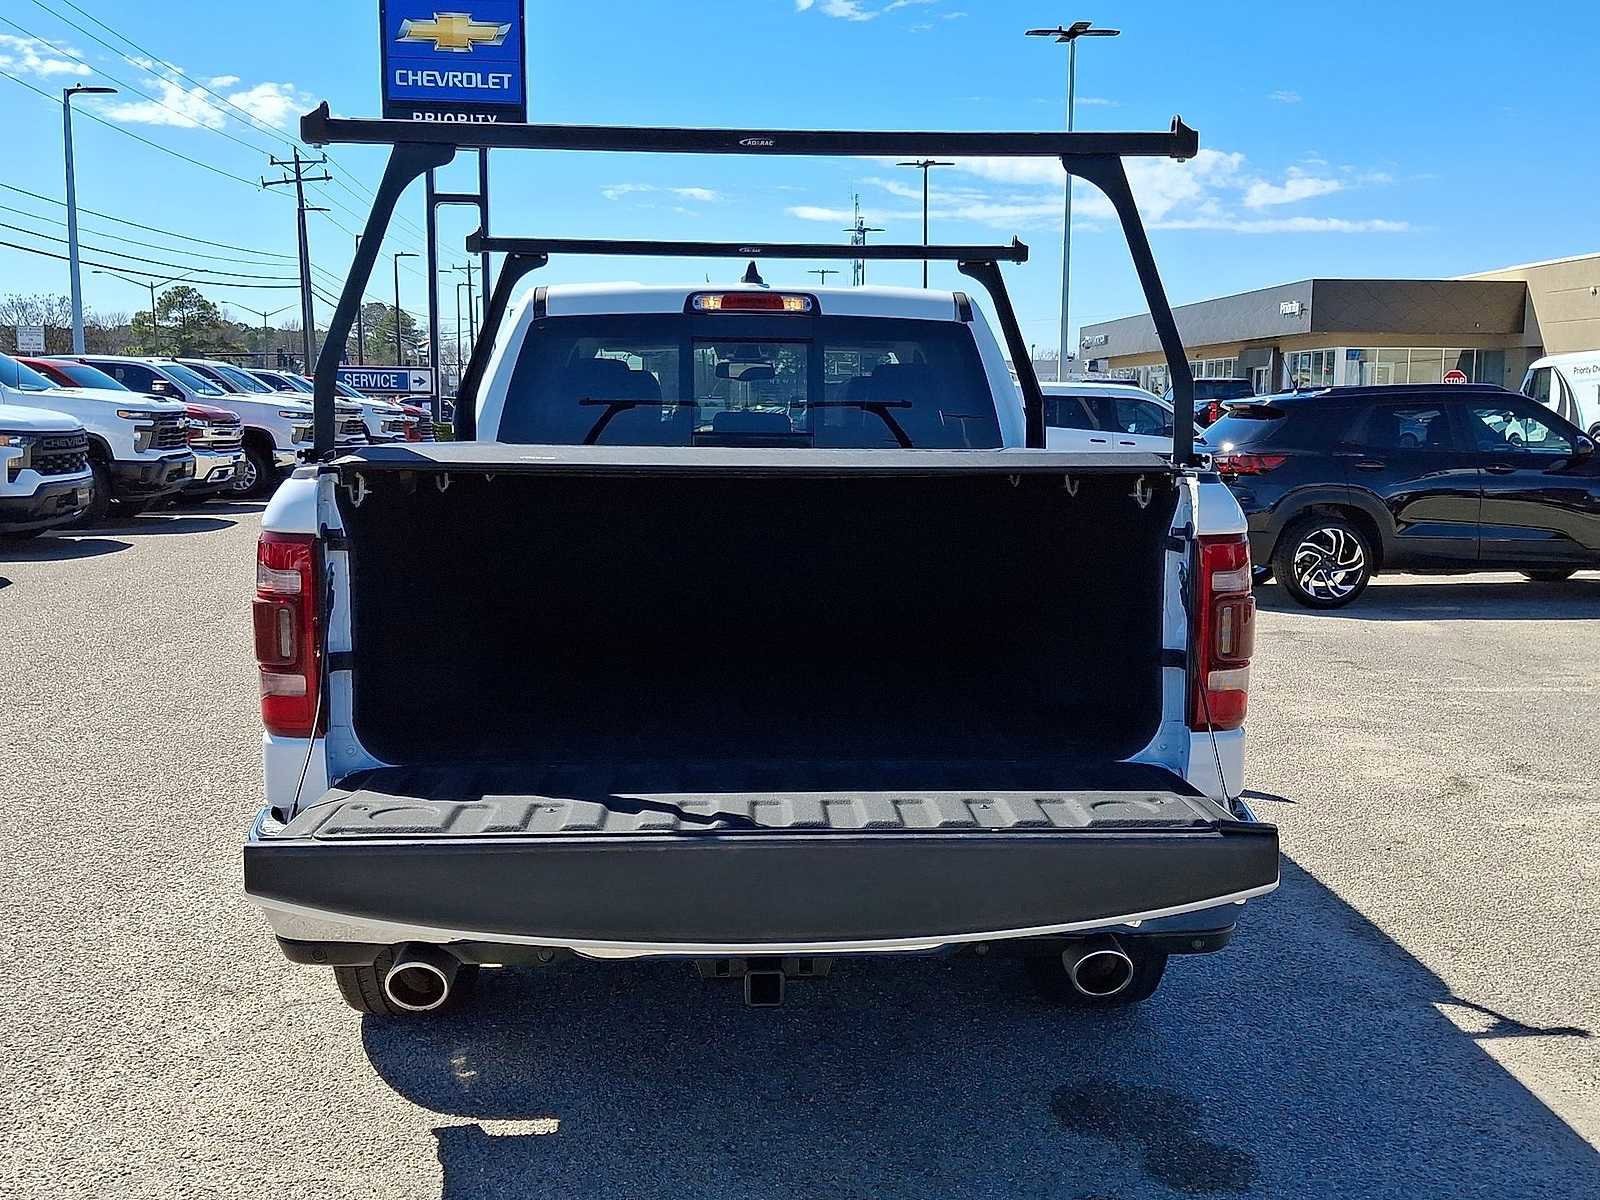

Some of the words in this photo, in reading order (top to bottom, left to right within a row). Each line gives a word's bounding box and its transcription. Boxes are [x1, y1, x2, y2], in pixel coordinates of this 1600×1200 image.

[395, 70, 512, 89] CHEVROLET
[412, 112, 497, 123] PRIORITY
[343, 373, 399, 388] SERVICE
